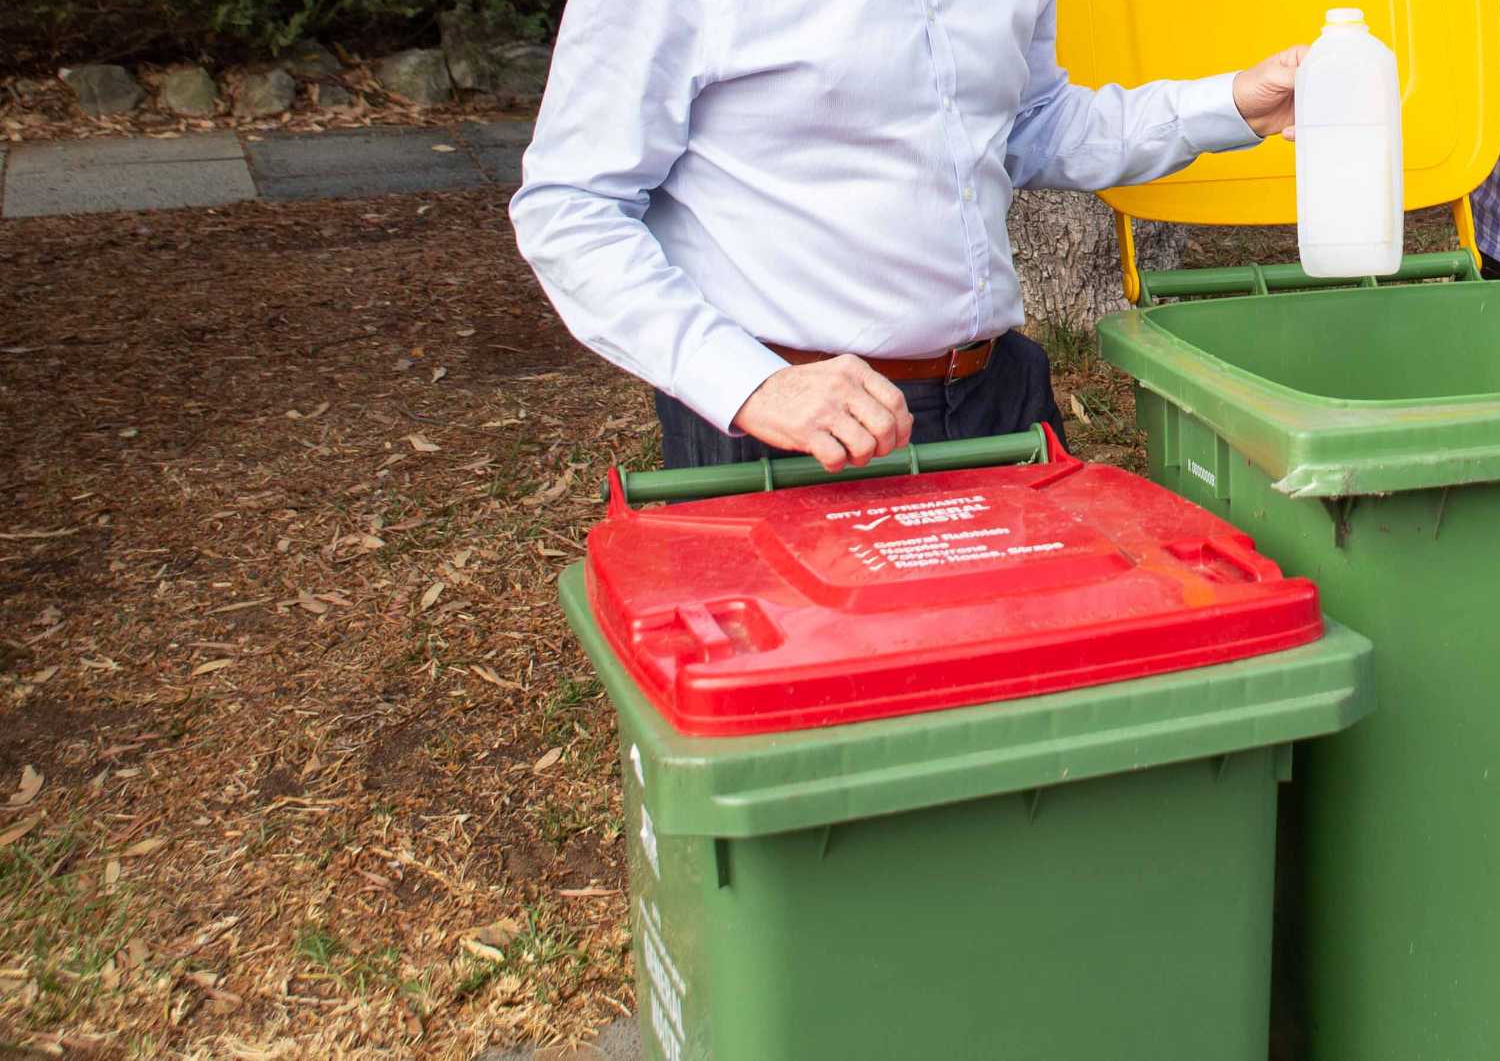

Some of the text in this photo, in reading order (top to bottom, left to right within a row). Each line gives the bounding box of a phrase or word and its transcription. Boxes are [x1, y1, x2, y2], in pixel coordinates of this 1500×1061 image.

[826, 495, 986, 520] CITY OF FREMANTLE
[894, 502, 991, 522] GENERAL
[900, 511, 976, 527] WASTE
[873, 526, 1010, 549] General Rubbish
[887, 543, 987, 563] Polystyrene
